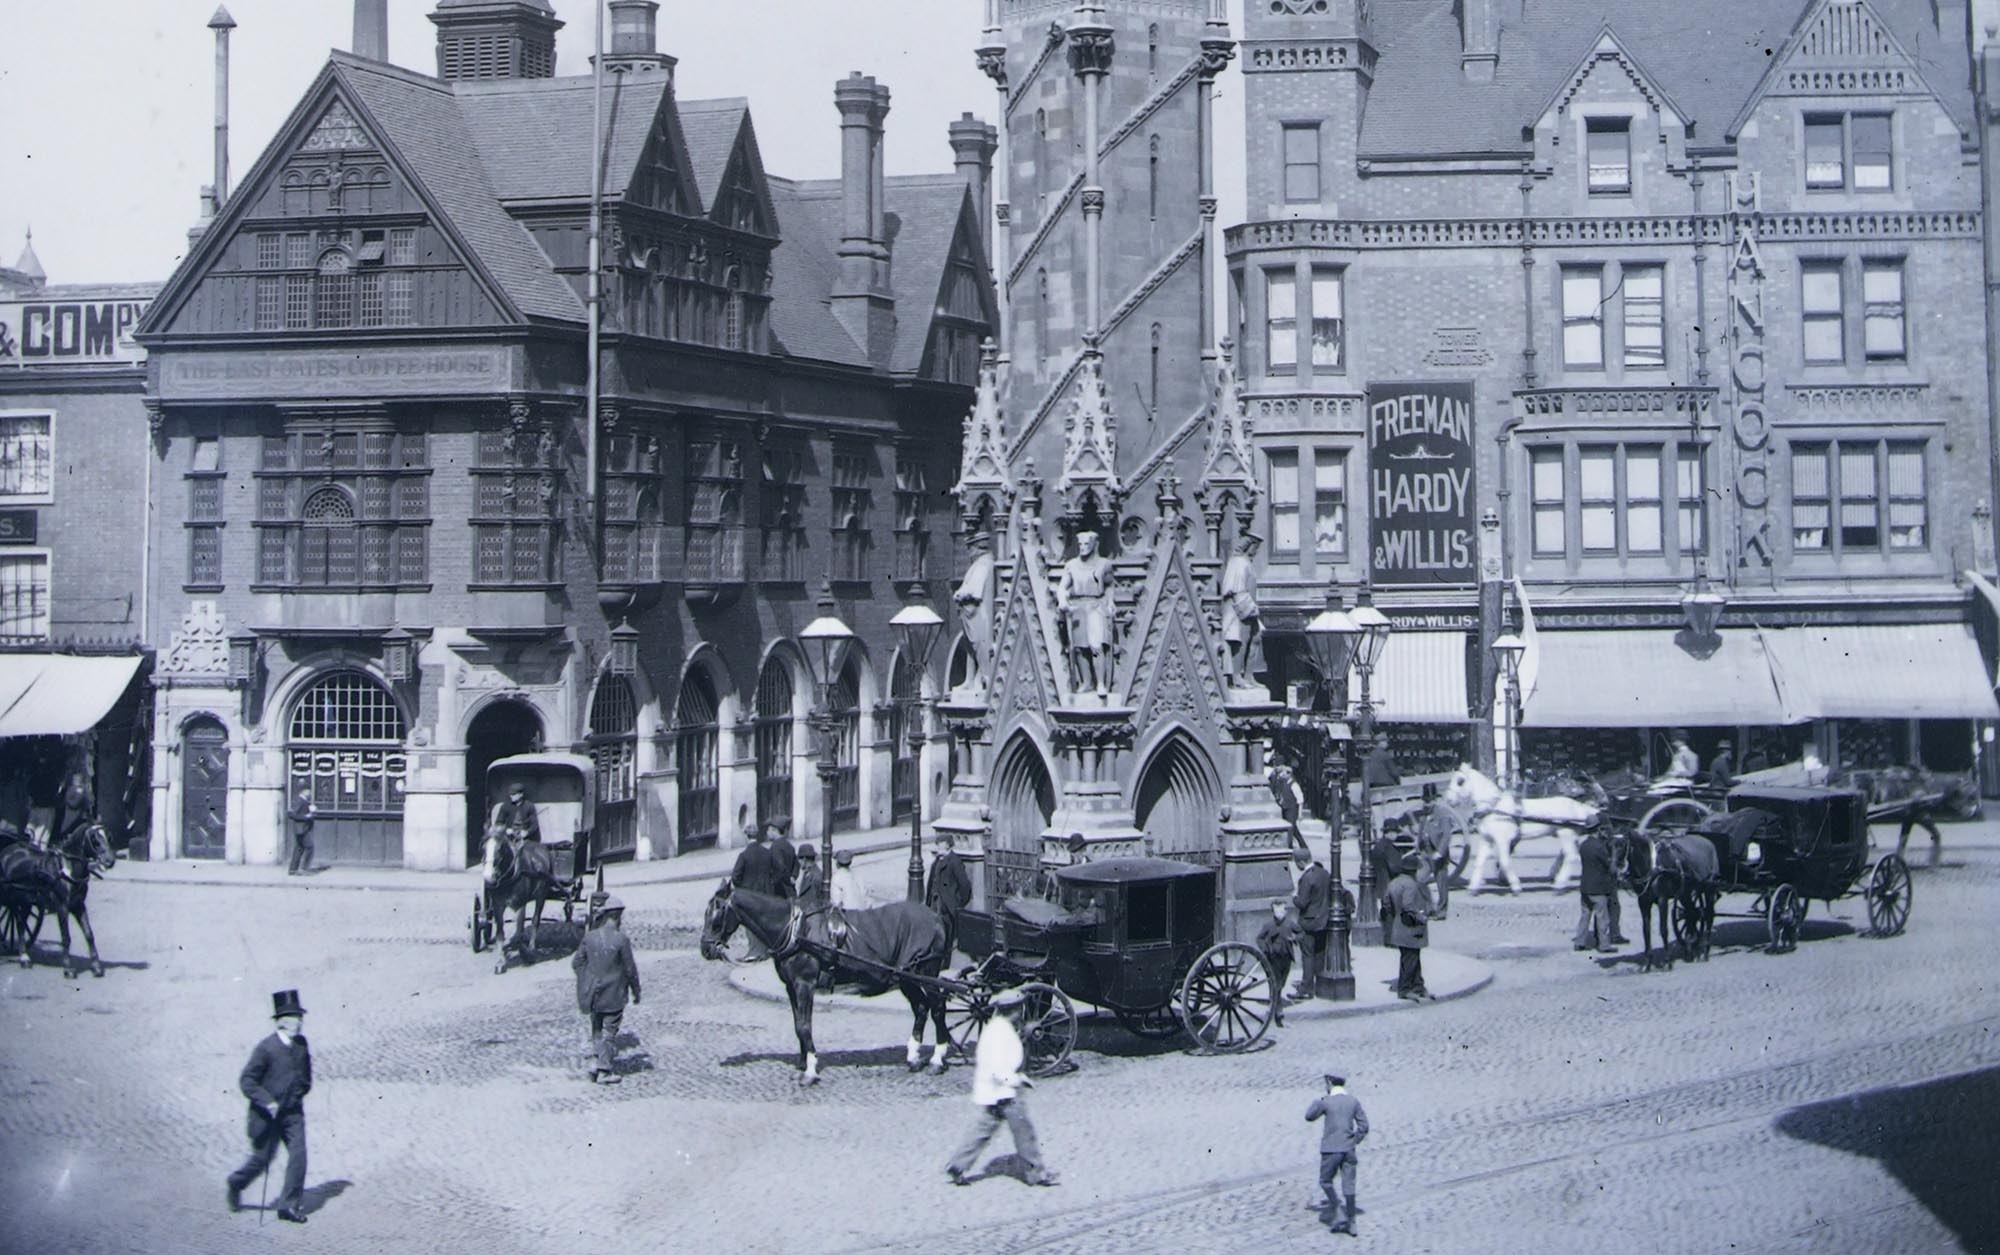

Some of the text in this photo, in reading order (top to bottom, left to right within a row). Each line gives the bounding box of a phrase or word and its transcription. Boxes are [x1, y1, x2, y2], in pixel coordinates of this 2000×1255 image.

[180, 361, 217, 379] THE
[427, 353, 491, 373] HOUSE
[1729, 171, 1771, 568] HANCOCK
[1371, 394, 1471, 449] FREEMAN
[1373, 467, 1471, 519] HARDY
[1533, 613, 1639, 627] ANCOCKS
